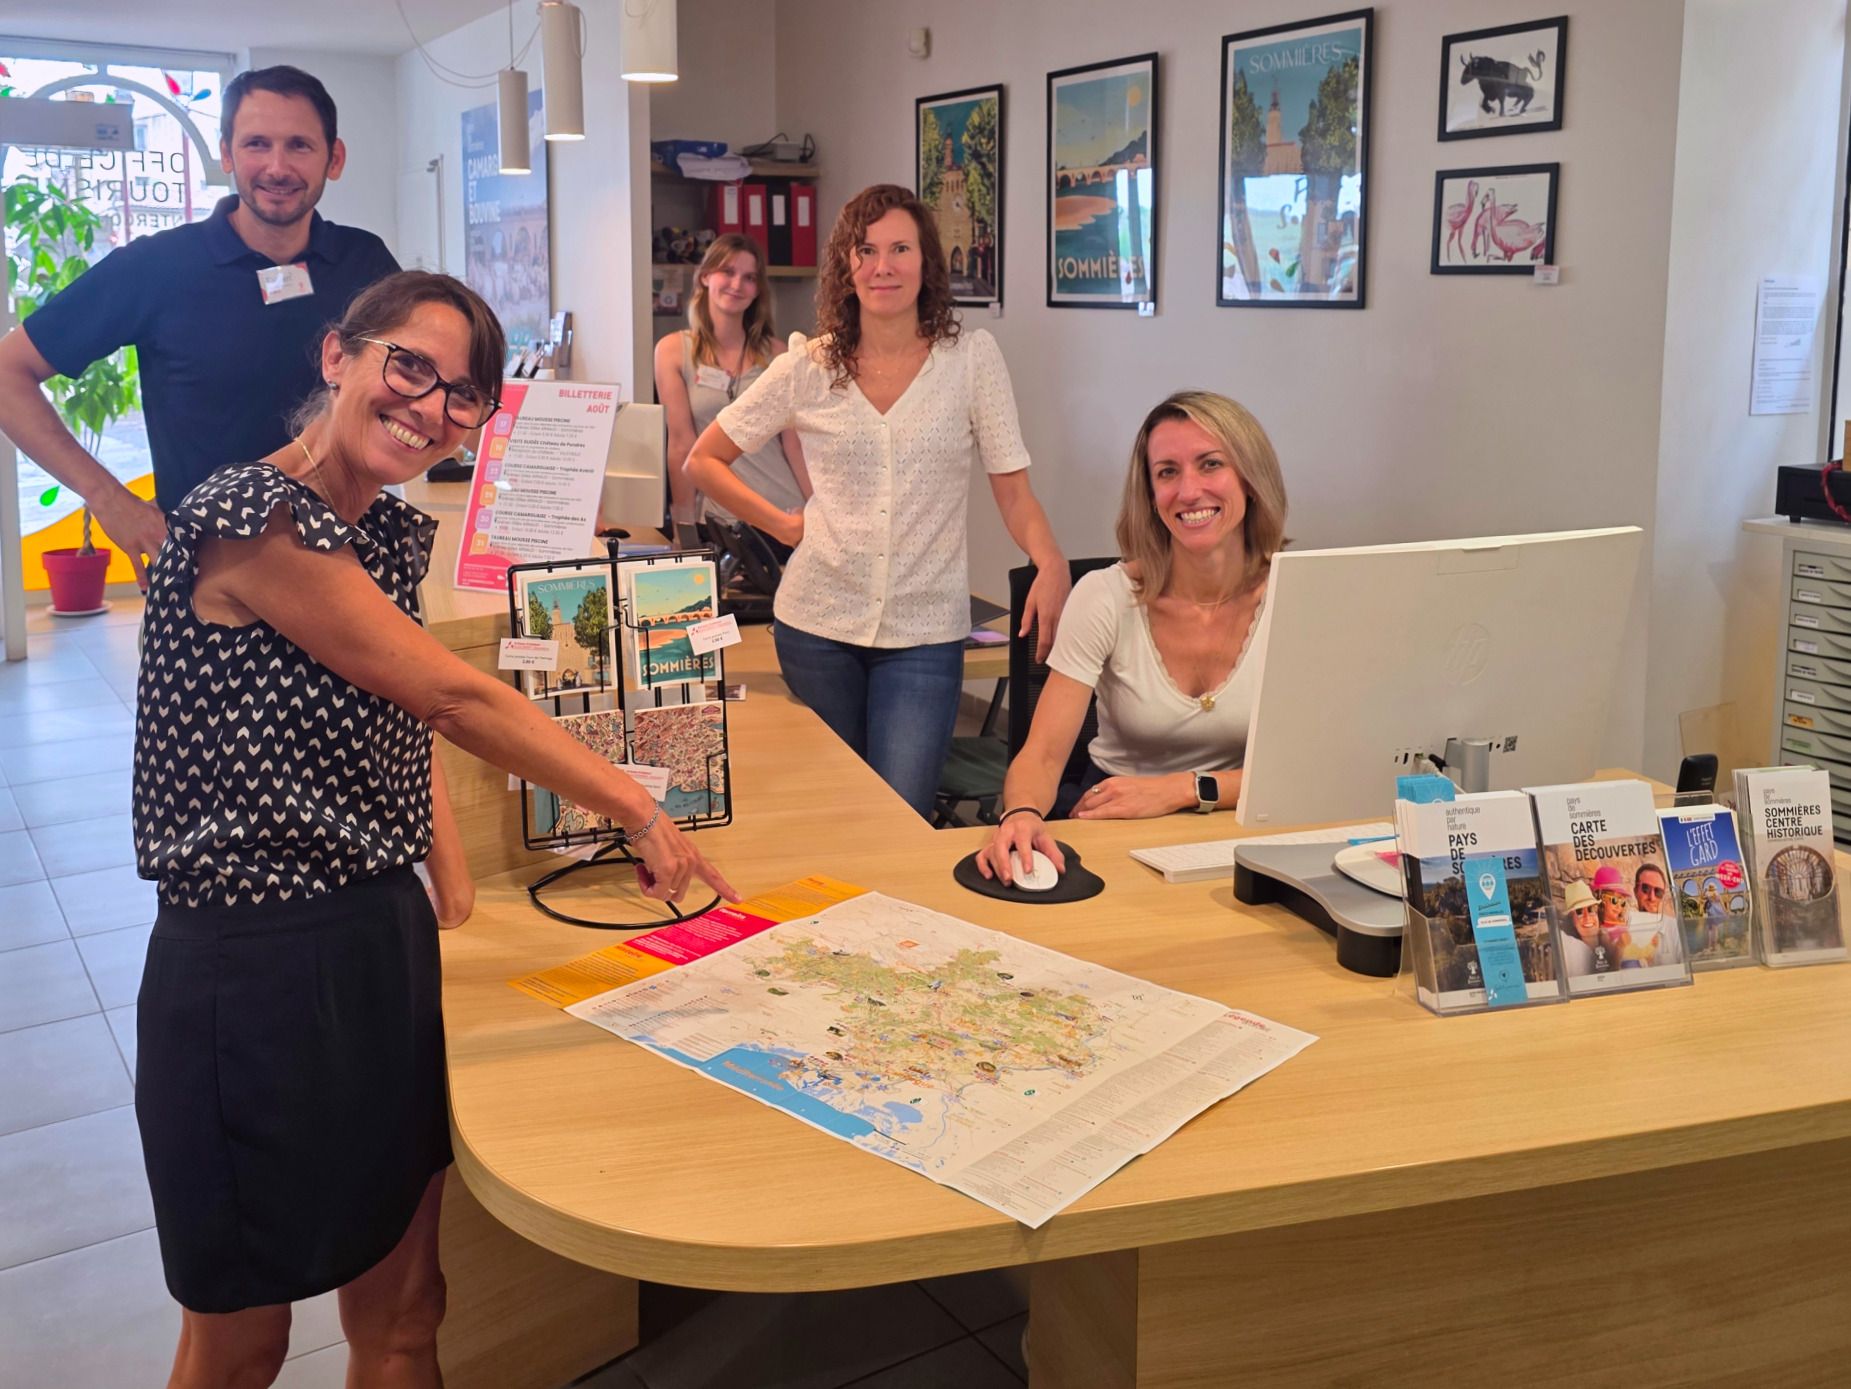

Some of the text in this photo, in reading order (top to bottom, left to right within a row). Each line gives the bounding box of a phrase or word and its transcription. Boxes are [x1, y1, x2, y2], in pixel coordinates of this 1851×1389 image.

[468, 153, 499, 179] CAMARG
[1058, 249, 1145, 279] SOMMIÈES
[559, 389, 613, 400] BILLETTERIE
[587, 402, 609, 413] AOÛT
[642, 656, 715, 677] SOMMIÈRES
[1446, 806, 1481, 817] authentique
[1764, 803, 1822, 818] SOMMIÈRES
[1447, 816, 1456, 825] par
[1571, 819, 1608, 835] CARTE
[1766, 816, 1803, 829] CENTRE
[1686, 822, 1714, 848] L'EFFET
[1767, 825, 1824, 839] HISTORIQUE
[1448, 832, 1478, 847] PAYS
[1573, 834, 1596, 848] DES
[1450, 847, 1466, 861] DE
[1690, 840, 1718, 867] GARD
